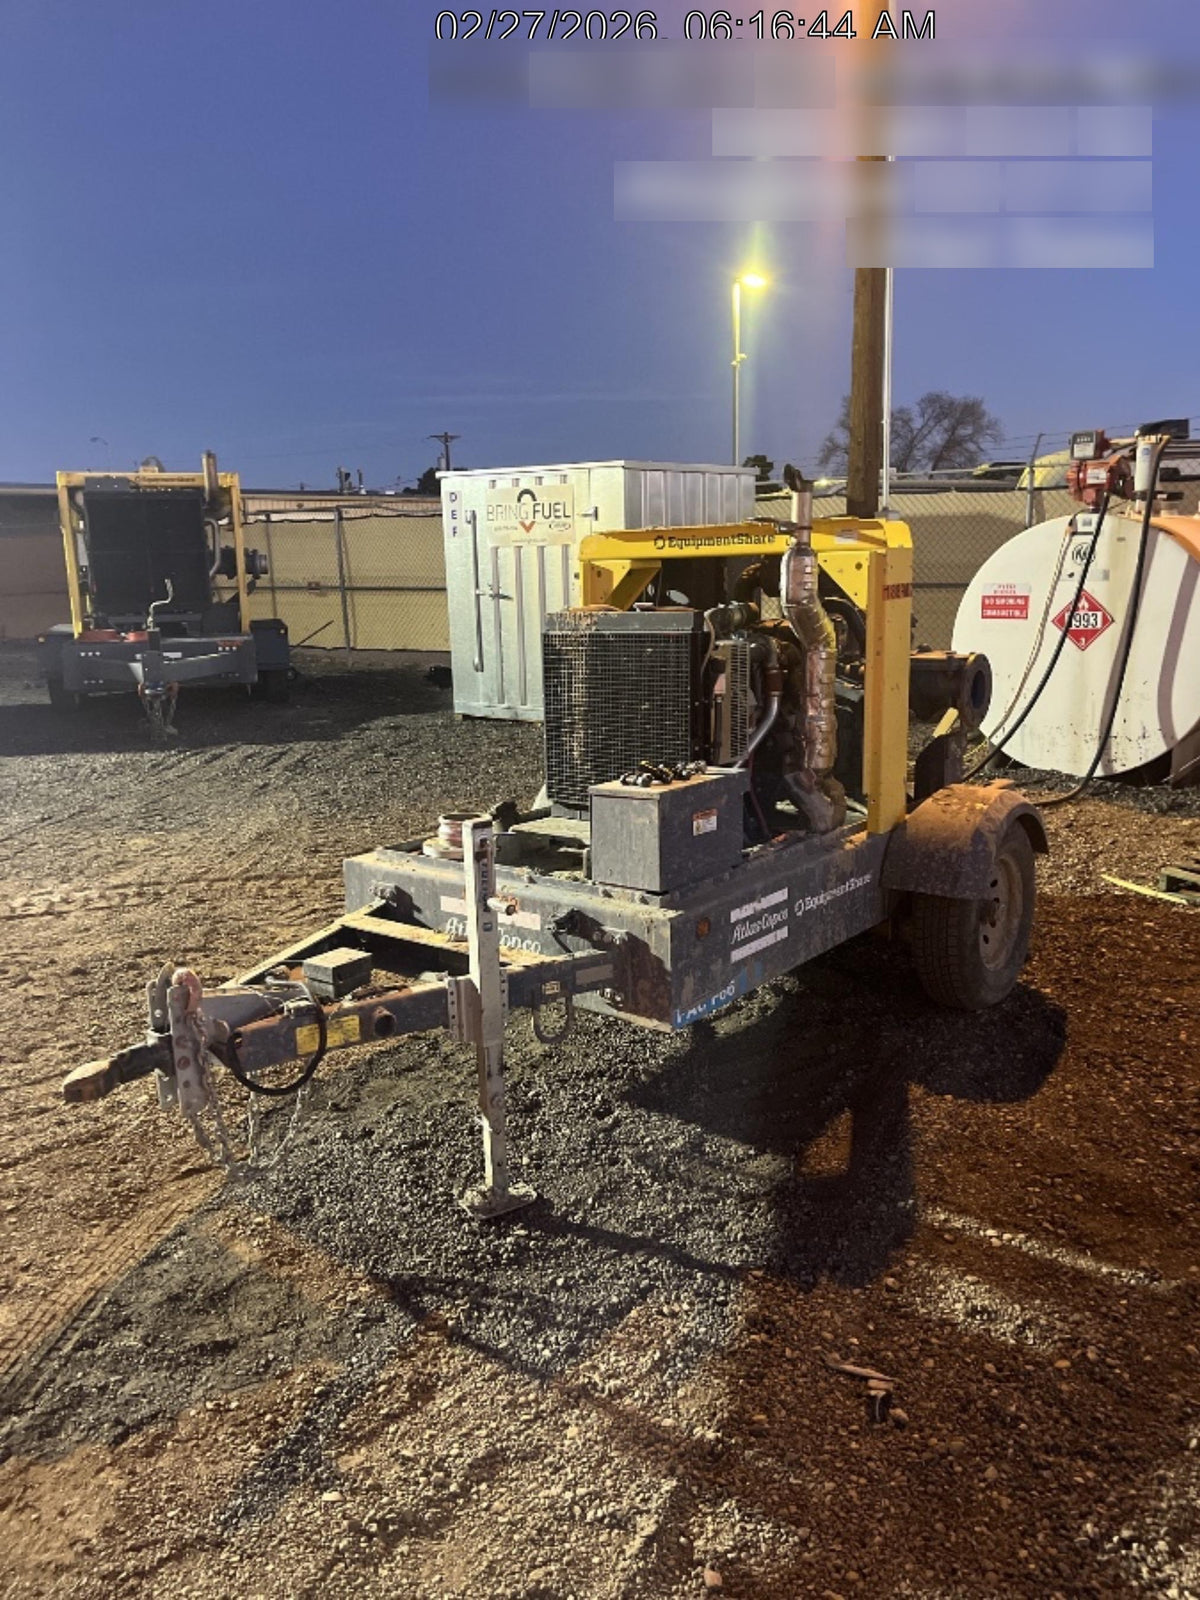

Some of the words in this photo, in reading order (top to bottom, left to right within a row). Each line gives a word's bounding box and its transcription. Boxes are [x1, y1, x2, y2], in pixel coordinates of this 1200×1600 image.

[486, 502, 529, 521] BRING
[532, 502, 571, 520] FUEL
[667, 532, 775, 550] EquipmentShare
[1068, 612, 1099, 629] 993
[731, 920, 761, 944] Atlas
[762, 908, 789, 930] Copco
